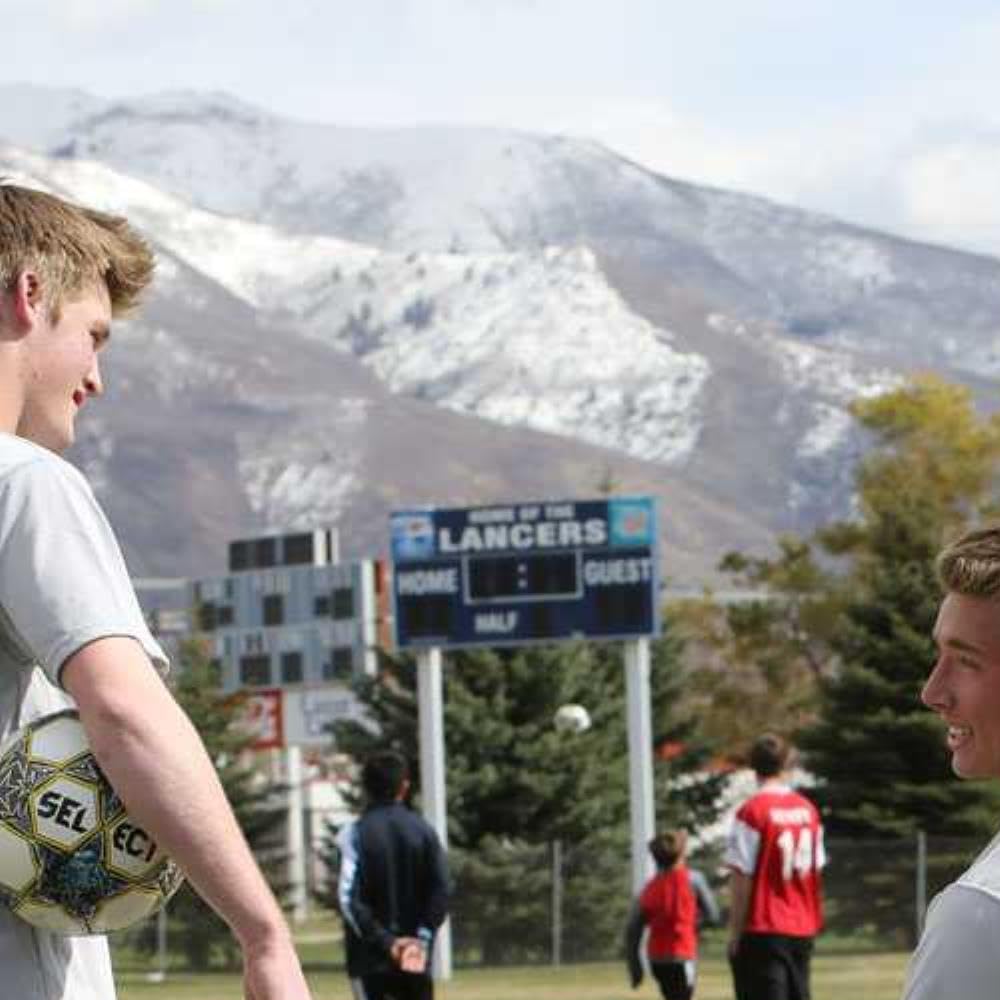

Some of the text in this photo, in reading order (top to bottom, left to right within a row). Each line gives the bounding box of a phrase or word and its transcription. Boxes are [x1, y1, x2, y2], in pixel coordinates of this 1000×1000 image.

[439, 519, 606, 552] LANCERS
[397, 570, 458, 594] HOME
[585, 559, 651, 585] GUEST
[474, 612, 518, 632] HALF
[37, 791, 88, 833] SEL
[777, 828, 812, 880] 14
